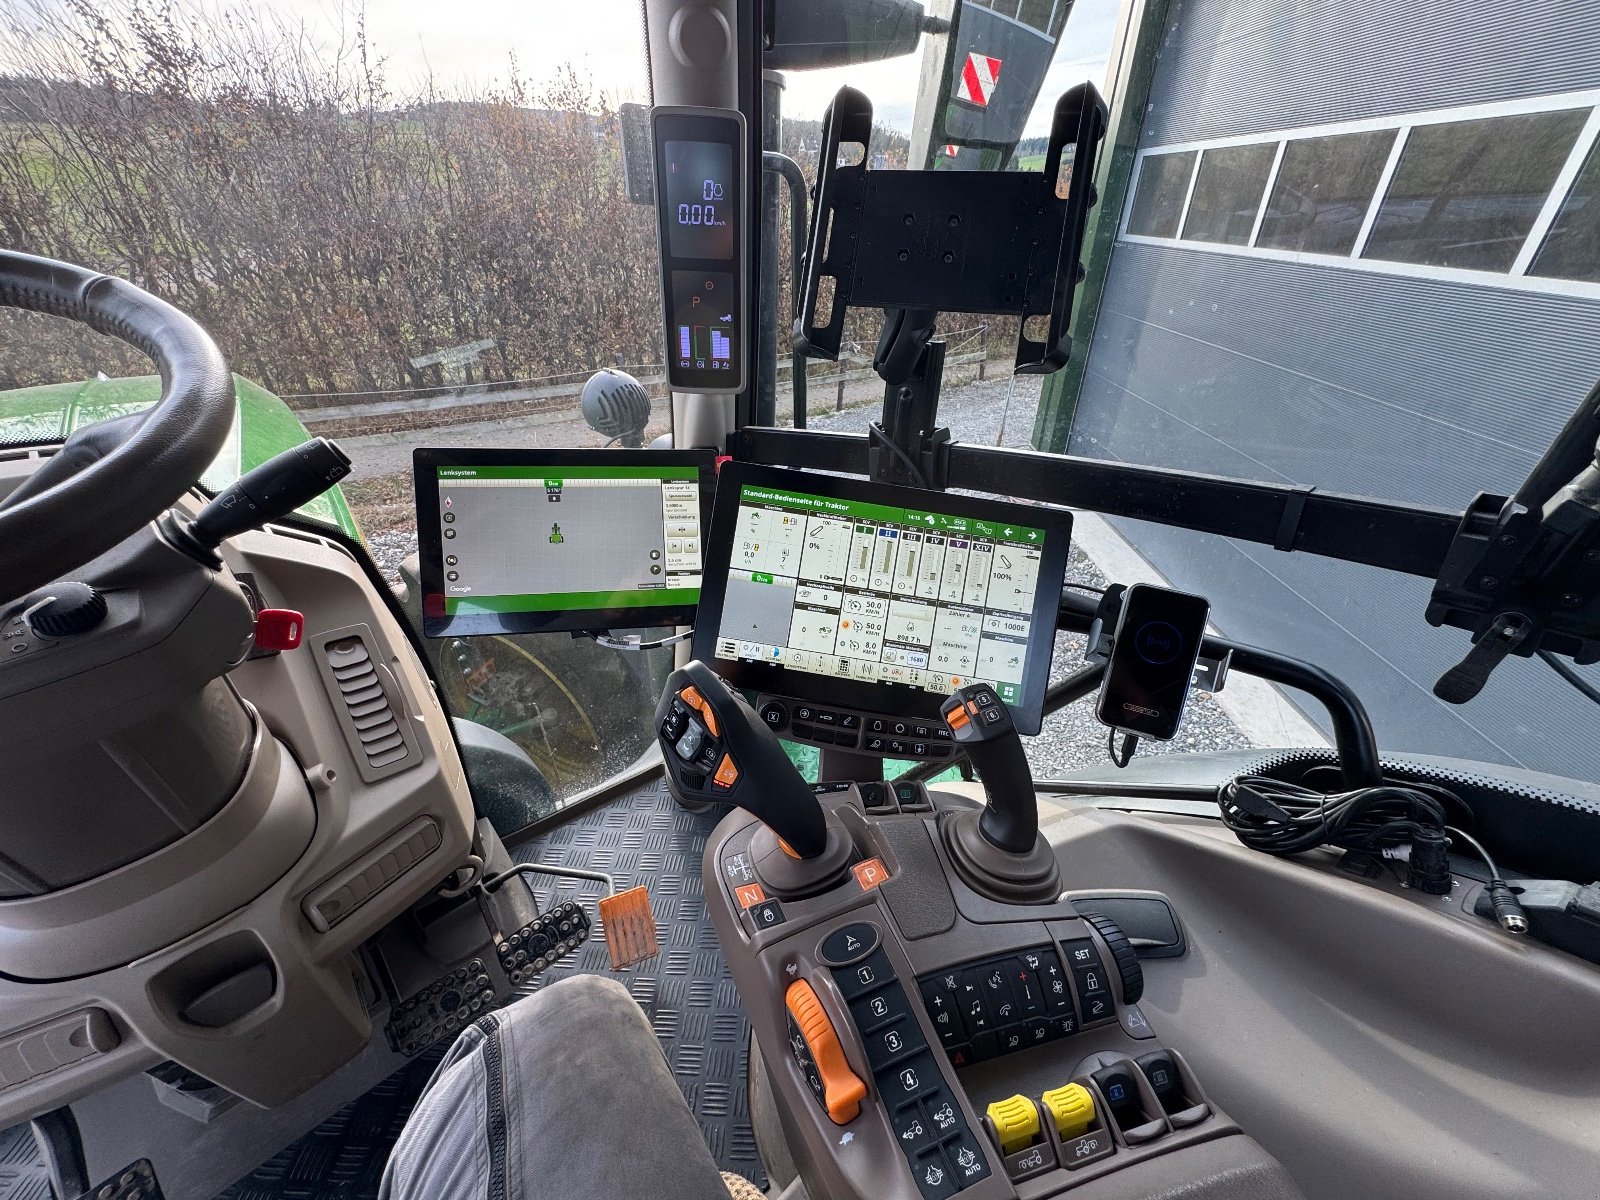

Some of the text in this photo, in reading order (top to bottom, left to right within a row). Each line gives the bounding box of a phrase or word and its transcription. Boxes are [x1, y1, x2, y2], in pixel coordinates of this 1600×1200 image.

[703, 180, 714, 200] 0
[743, 489, 813, 506] Standard-Bedienseite
[825, 501, 850, 511] Traktor
[907, 533, 917, 541] III
[930, 537, 940, 545] IV
[975, 543, 990, 552] XIV
[993, 572, 1012, 581] 100%
[1004, 622, 1025, 632] 1000E
[942, 641, 968, 650] Maschine
[910, 655, 924, 664] 1680
[864, 867, 876, 882] P
[744, 888, 758, 904] N
[847, 942, 861, 951] AUTO
[1074, 949, 1090, 960] SET
[862, 969, 871, 981] 1
[874, 1001, 885, 1013] 2
[888, 1035, 898, 1048] 3
[905, 1073, 915, 1086] 4
[939, 1117, 956, 1129] AUTO
[964, 1164, 981, 1177] AUTO
